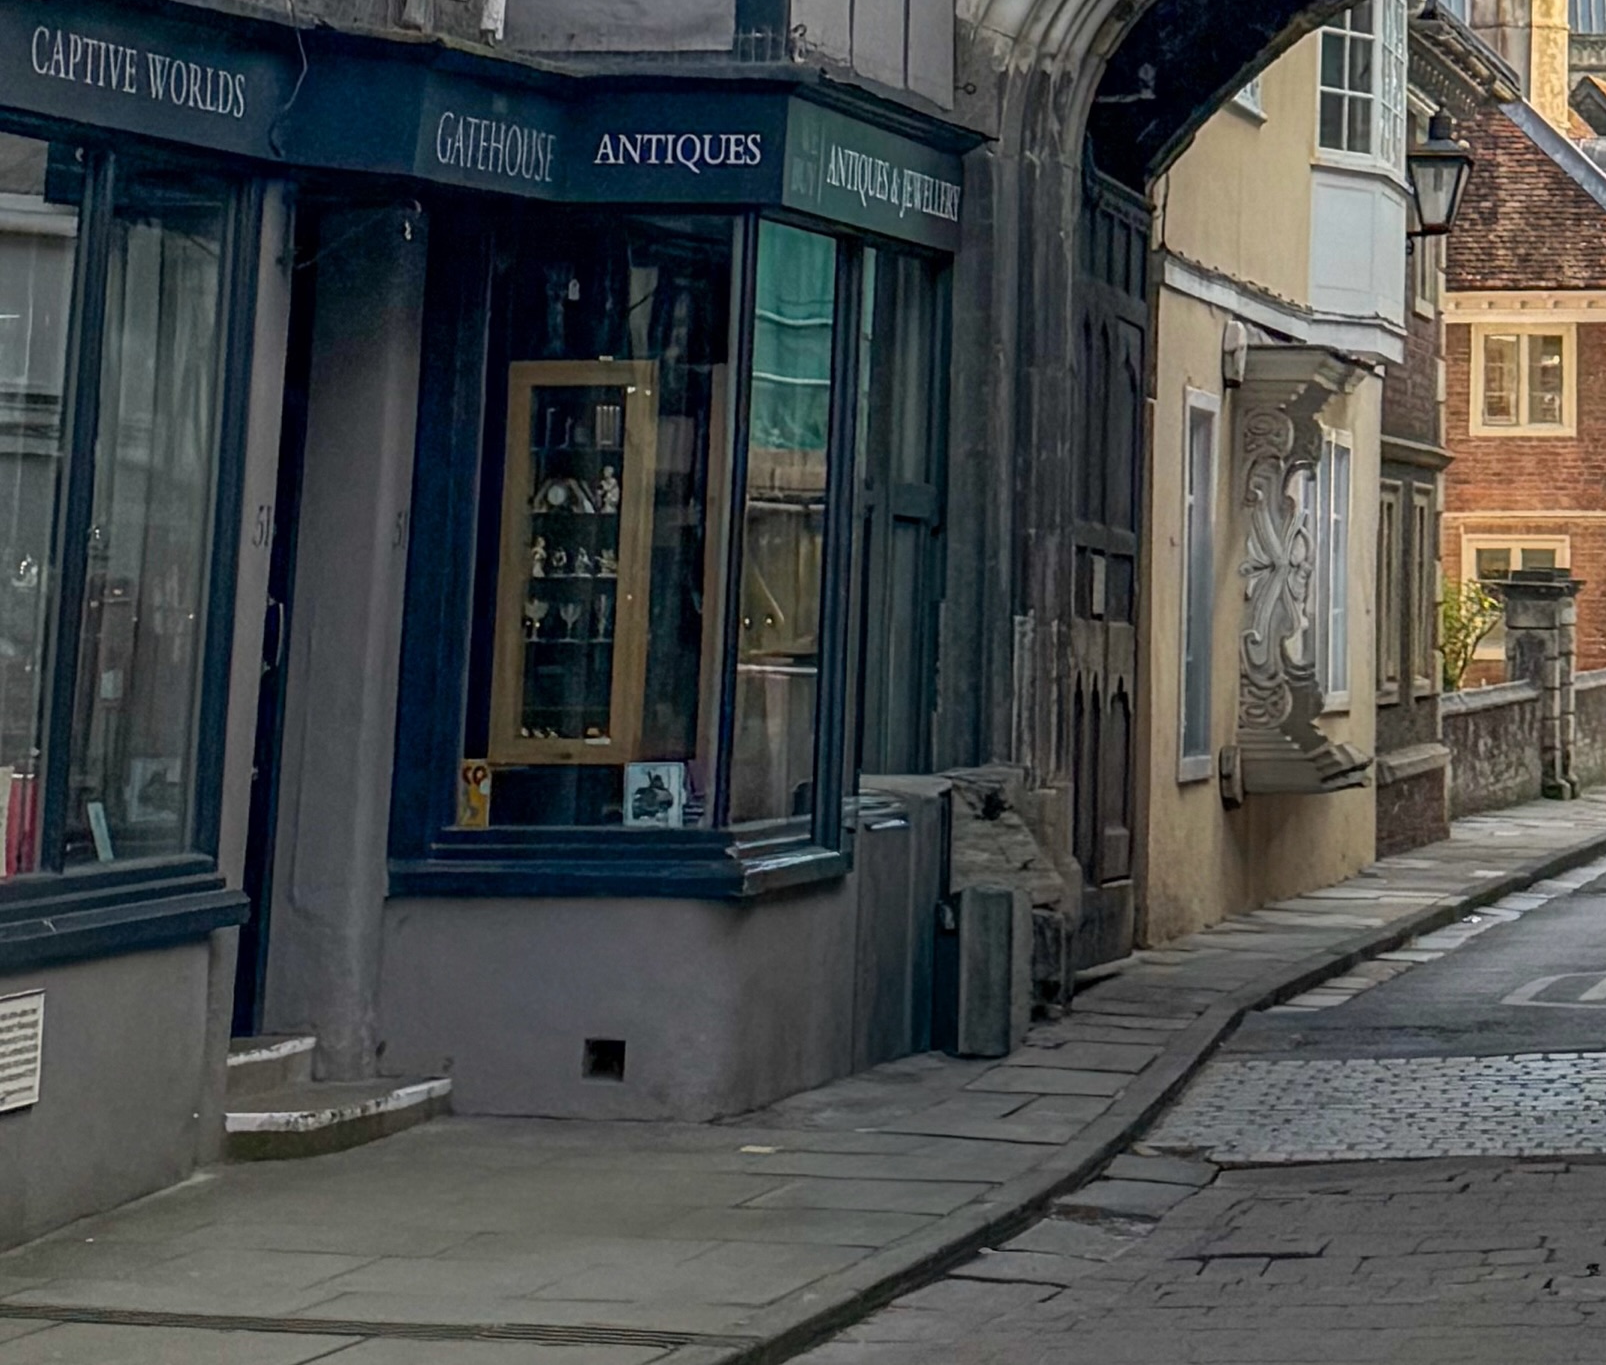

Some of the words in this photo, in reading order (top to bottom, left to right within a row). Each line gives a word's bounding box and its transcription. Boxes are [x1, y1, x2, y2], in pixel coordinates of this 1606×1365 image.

[31, 25, 137, 94] CAPTIVE
[147, 52, 246, 118] WORLDS
[436, 111, 556, 183] GATEHOUSE
[594, 133, 761, 174] ANTIQUES
[826, 143, 890, 208] ANTIQUES
[890, 168, 901, 205] &
[899, 168, 962, 222] JEWELLERY
